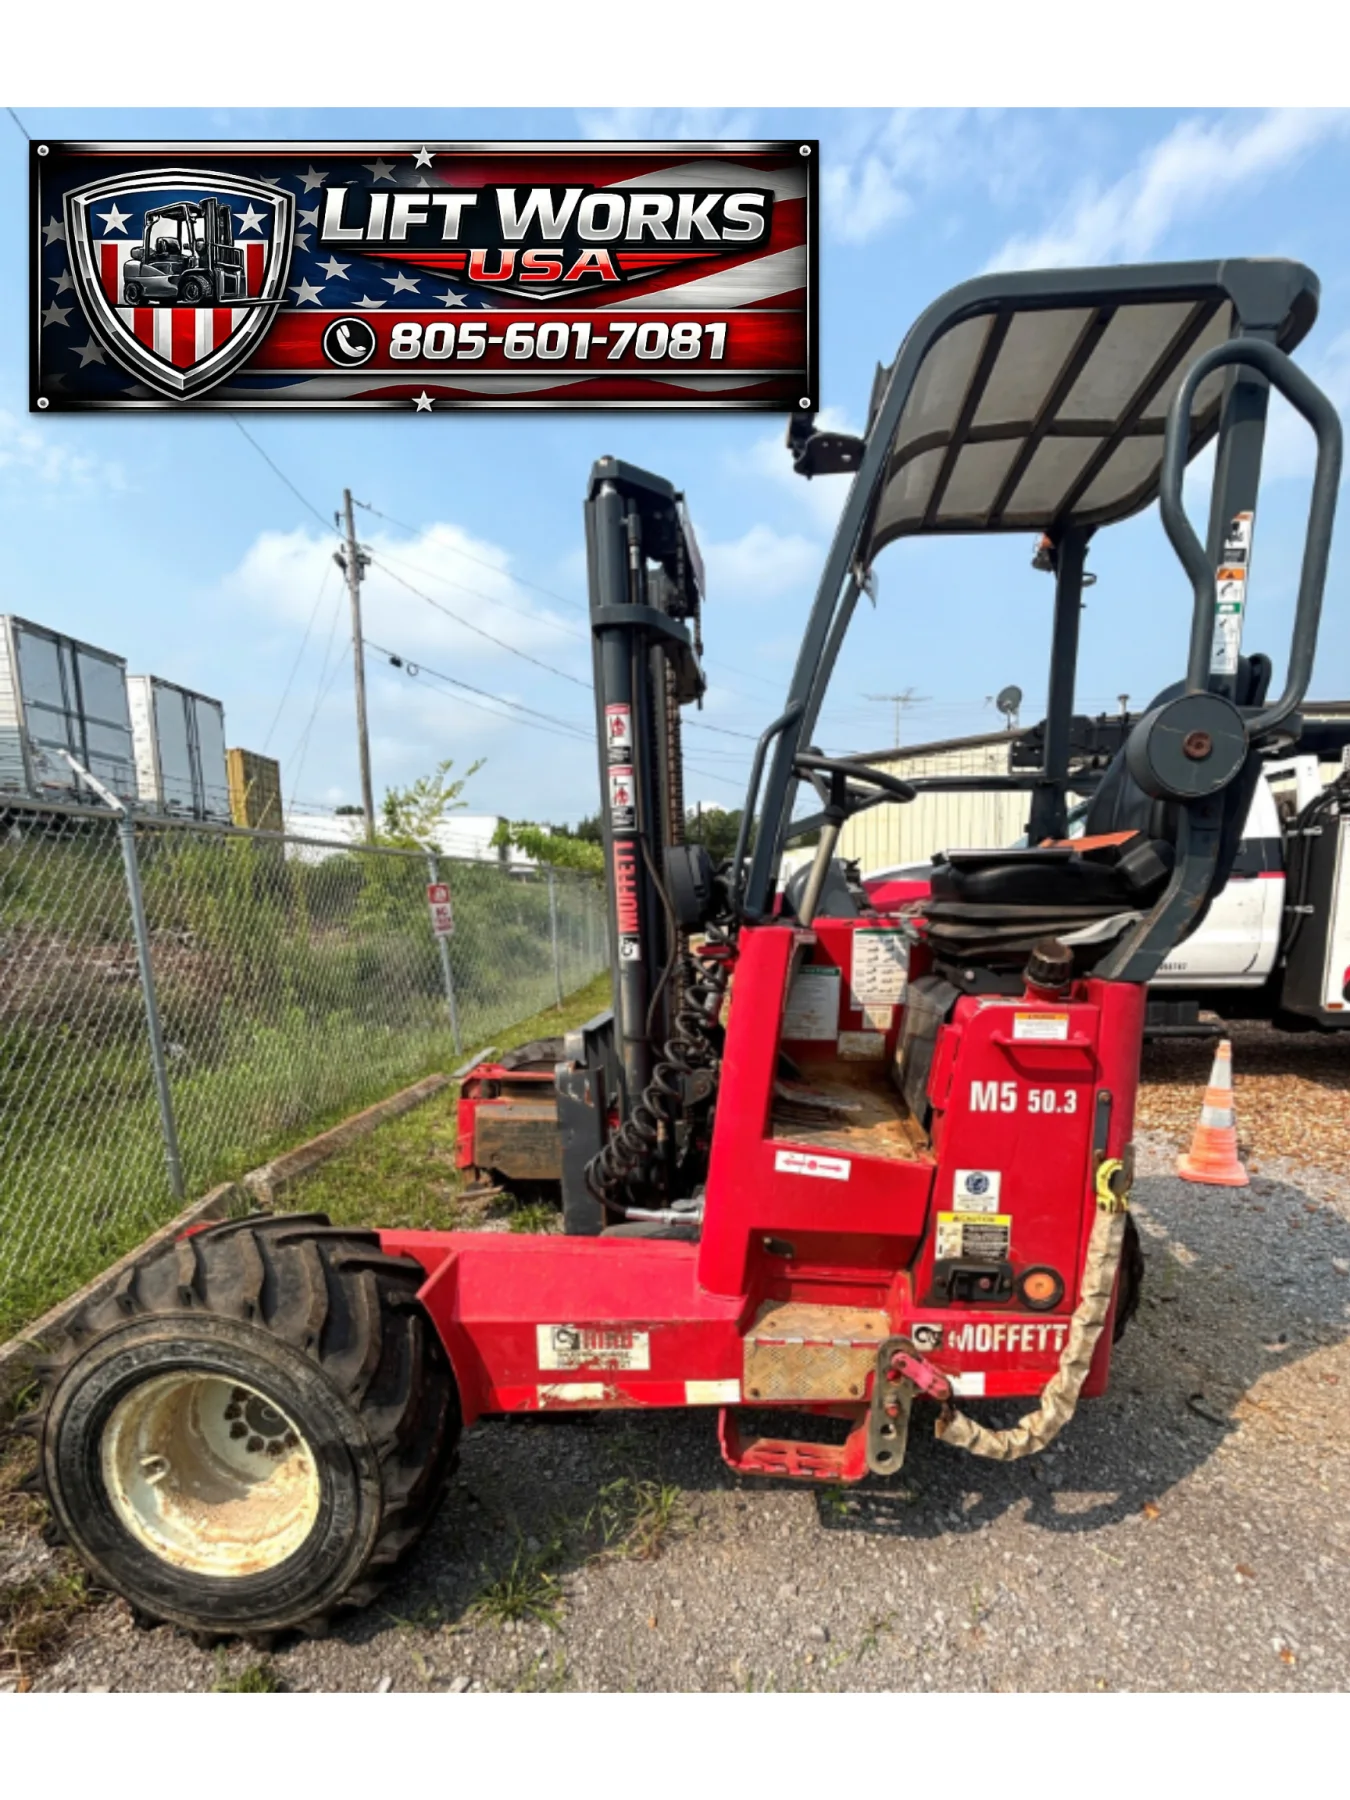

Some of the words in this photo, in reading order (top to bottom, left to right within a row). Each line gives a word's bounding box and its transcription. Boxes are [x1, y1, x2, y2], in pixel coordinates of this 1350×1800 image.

[613, 839, 639, 934] MOFFETT
[970, 1080, 1018, 1113] M5
[1027, 1088, 1077, 1113] 50.3
